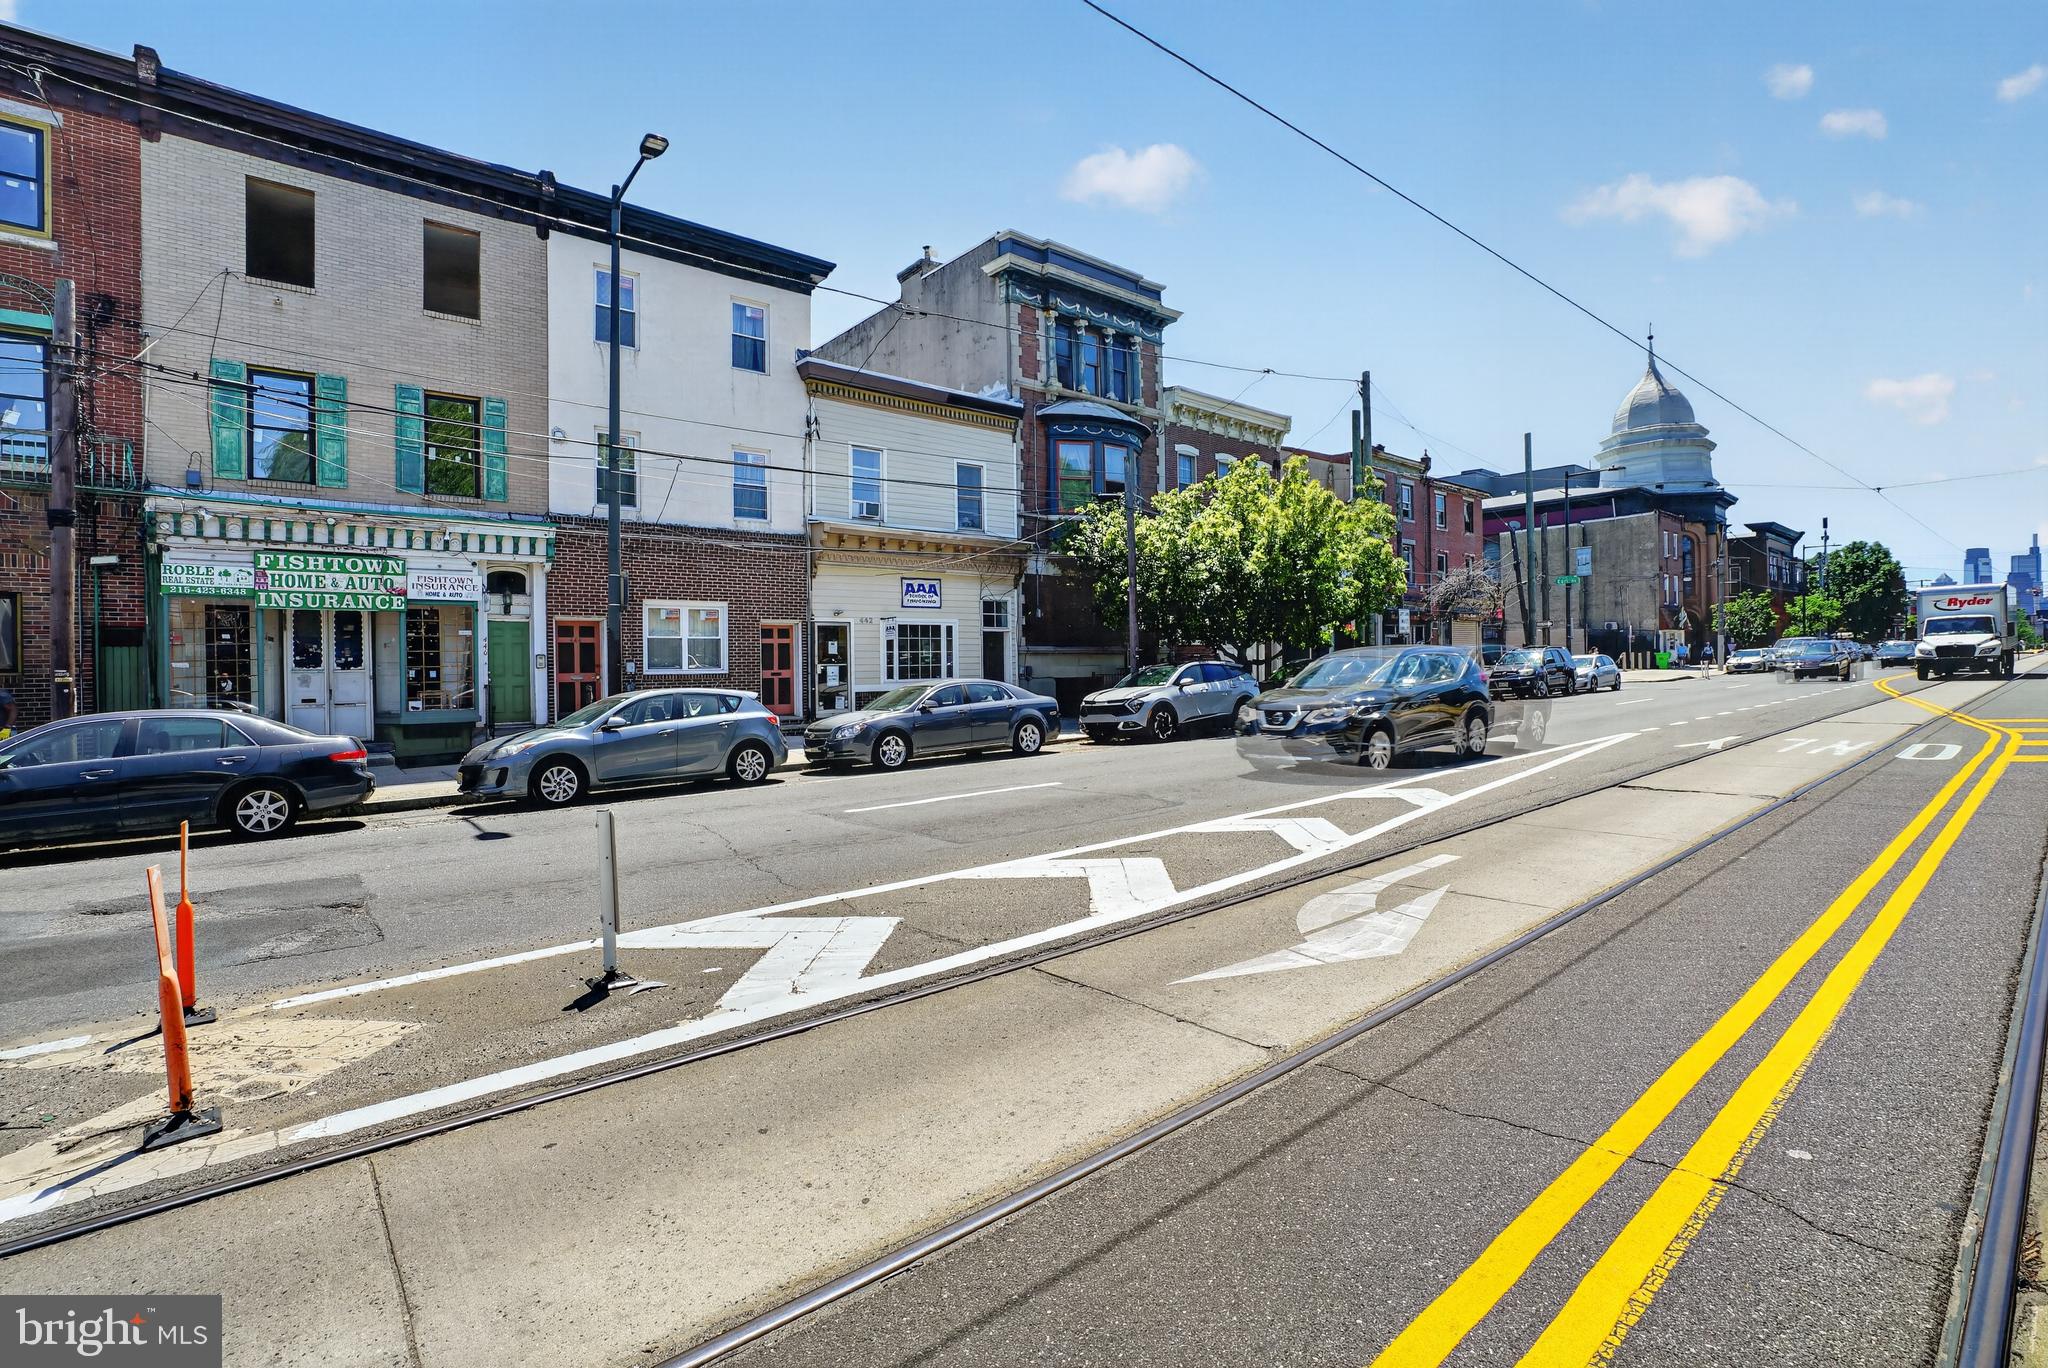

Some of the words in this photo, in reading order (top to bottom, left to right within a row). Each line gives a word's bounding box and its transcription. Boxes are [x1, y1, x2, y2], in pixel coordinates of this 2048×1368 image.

[257, 553, 404, 574] FISHTOWN
[162, 564, 215, 576] ROBLE
[162, 575, 181, 584] REAL
[185, 576, 215, 585] ESTATE
[270, 573, 326, 589] HOME
[330, 577, 340, 588] &
[345, 576, 394, 591] AUTO
[416, 575, 473, 585] FISHTOWN
[169, 586, 246, 595] 215-423-6348
[411, 582, 479, 592] INSURANCE
[904, 583, 939, 597] AAA
[257, 592, 405, 609] INSURANCE
[1947, 596, 1993, 608] Ryder
